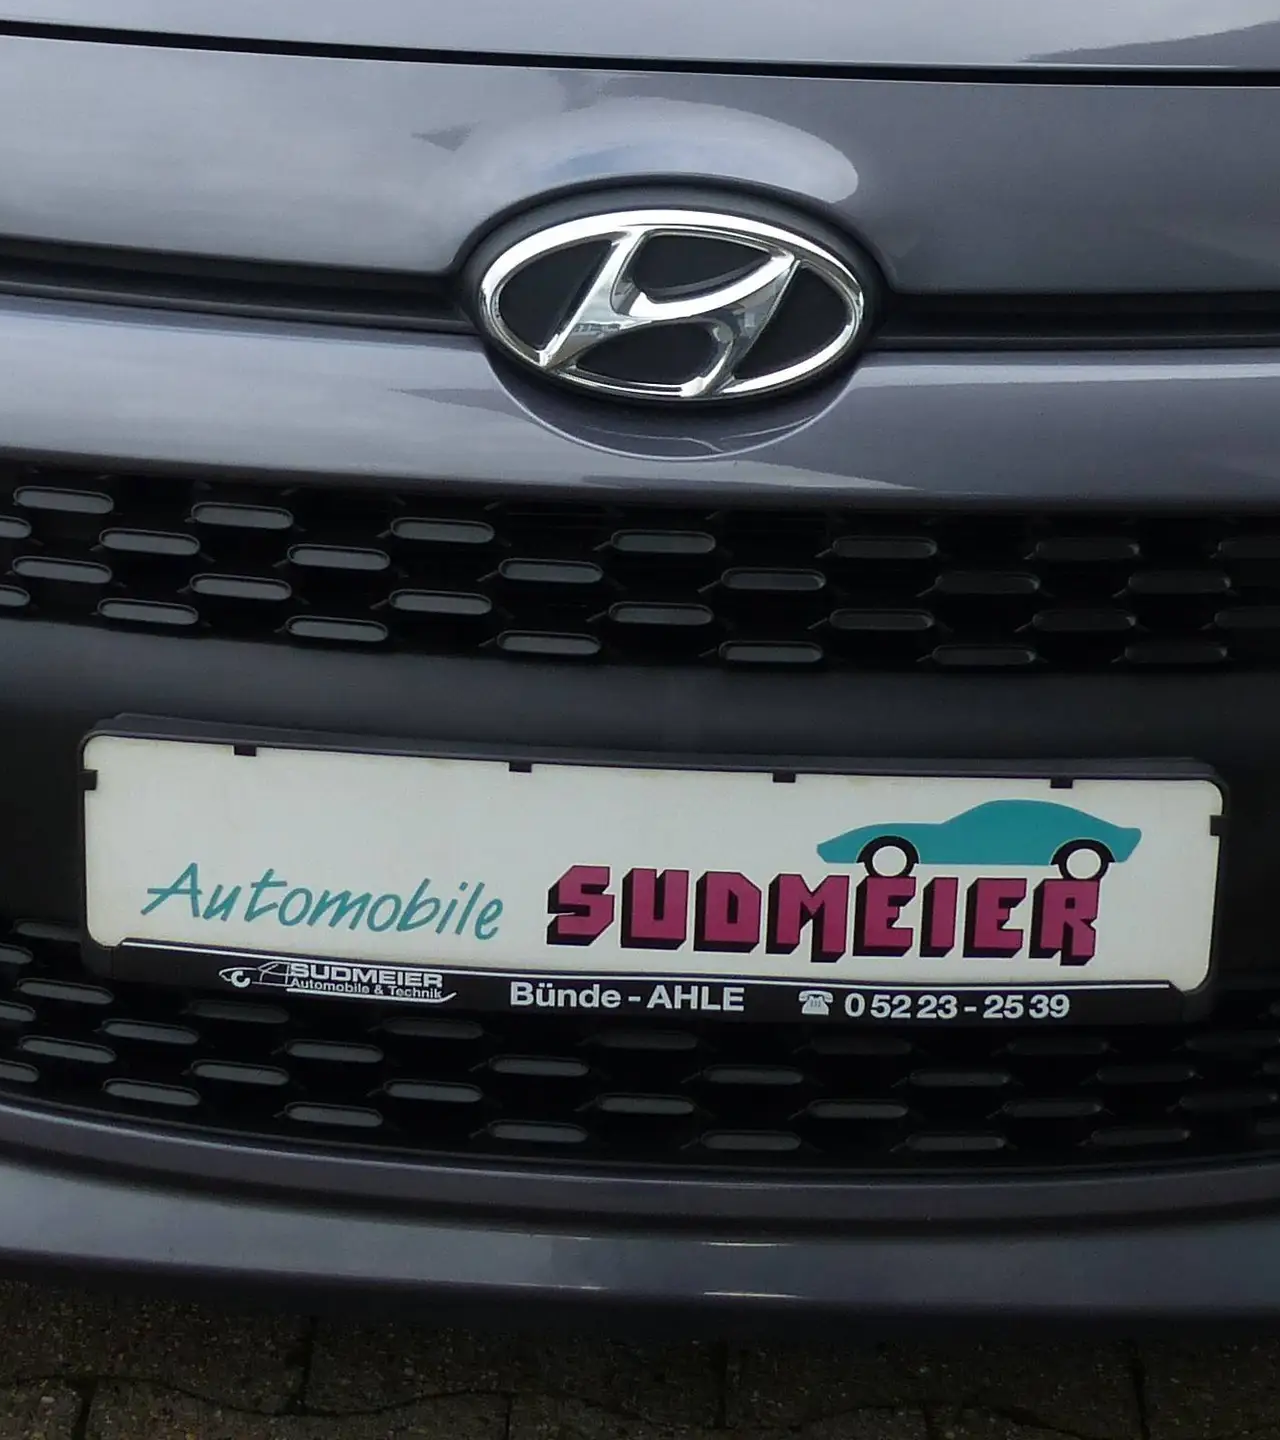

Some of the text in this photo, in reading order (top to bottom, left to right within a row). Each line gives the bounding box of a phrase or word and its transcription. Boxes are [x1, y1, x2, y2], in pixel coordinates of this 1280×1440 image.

[140, 862, 504, 940] Automobile
[547, 865, 1101, 966] SUDMEIER
[290, 963, 443, 988] SUDMEIER
[290, 977, 443, 999] Automobile & Technik
